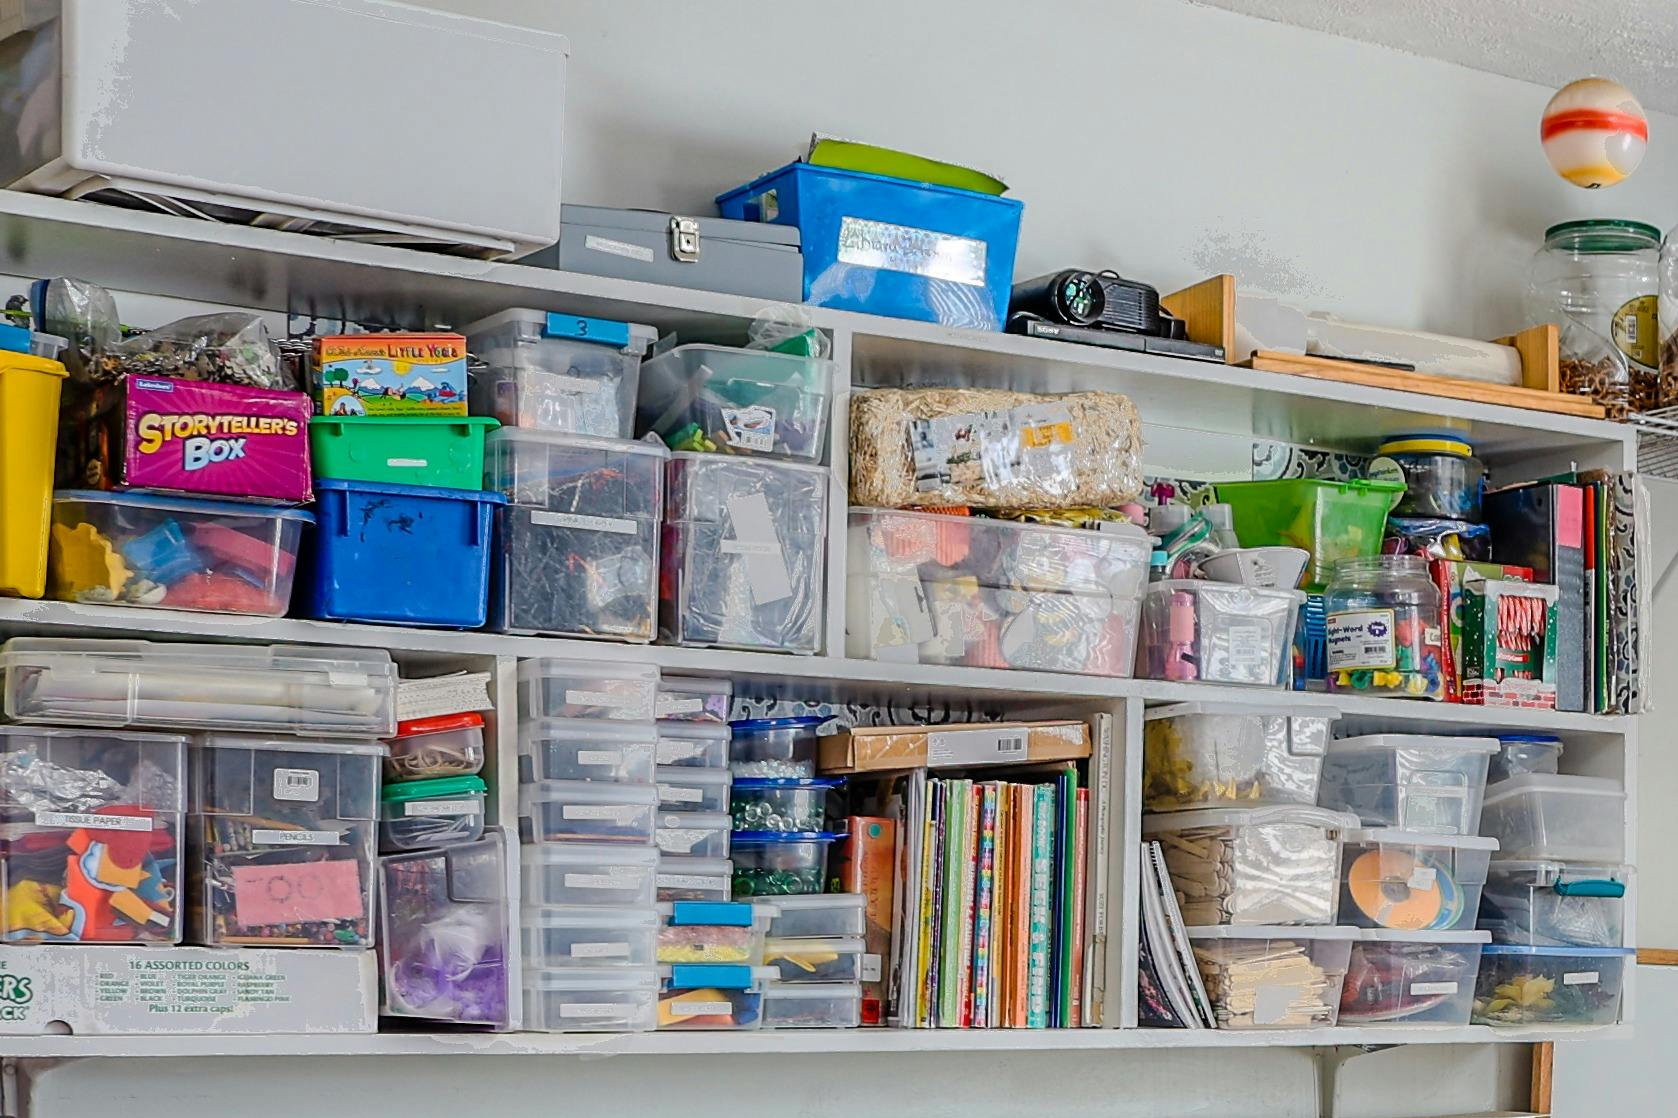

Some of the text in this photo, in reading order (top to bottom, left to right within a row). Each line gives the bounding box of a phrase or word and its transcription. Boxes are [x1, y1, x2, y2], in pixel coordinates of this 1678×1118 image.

[578, 320, 587, 336] 3
[388, 344, 424, 358] LITTLE
[138, 413, 298, 454] STORYTELLER'S
[185, 438, 246, 471] BOX
[65, 815, 122, 825] TISSUE PAPER
[130, 961, 249, 970] 16 ASSORTED COLORS
[149, 1004, 168, 1013] Plus
[171, 1005, 181, 1013] 12
[185, 1005, 207, 1013] extra
